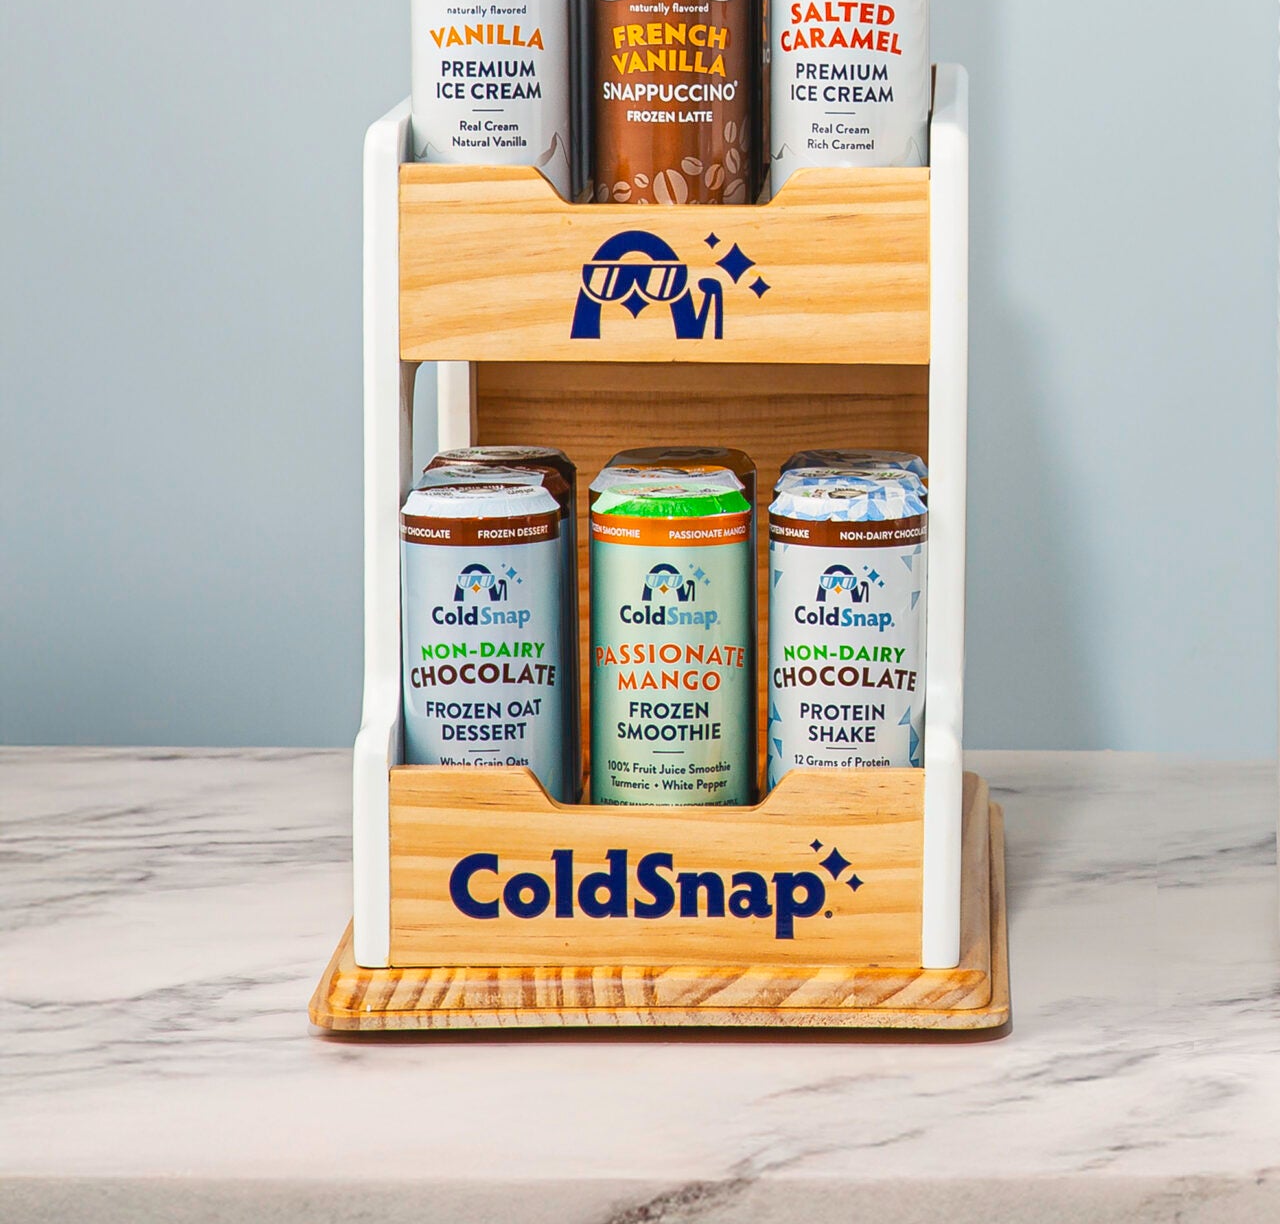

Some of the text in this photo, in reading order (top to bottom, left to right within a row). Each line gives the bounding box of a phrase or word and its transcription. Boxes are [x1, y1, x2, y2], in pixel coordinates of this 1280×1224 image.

[447, 5, 527, 18] naturally flavored
[629, 3, 709, 16] naturally flavored
[791, 1, 896, 26] SALTED
[429, 23, 545, 51] VANILLA
[612, 22, 728, 50] FRENCH
[780, 26, 903, 56] CARAMEL
[441, 60, 536, 78] PREMIUM
[611, 49, 727, 77] VANILLA
[796, 63, 889, 81] PREMIUM
[436, 81, 542, 100] ICE CREAM
[791, 84, 894, 103] ICE CREAM
[459, 120, 519, 131] Real Cream
[627, 110, 713, 123] FROZEN LATTE
[811, 122, 870, 135] Real Cream
[452, 136, 527, 147] Natural Vanilla
[807, 138, 875, 151] Rich Caramel
[407, 526, 451, 539] CHOCOLATE
[477, 525, 549, 539] FROZEN DESSERT
[602, 526, 640, 538] SMOOTHIE
[669, 525, 746, 539] PASSIONATE MANGO
[785, 528, 810, 539] SHAKE
[840, 531, 894, 541] NON-DAIRY
[431, 606, 531, 629] ColdSnap
[619, 605, 718, 630] ColdSnap
[794, 606, 893, 632] ColdSnap
[421, 642, 545, 661] NON-DAIRY
[596, 644, 745, 668] PASSIONATE
[784, 645, 906, 664] NON-DAIRY
[410, 663, 556, 688] CHOCOLATE
[617, 671, 721, 691] MANGO
[773, 666, 917, 692] CHOCOLATE
[426, 698, 542, 719] FROZEN OAT
[629, 701, 709, 719] FROZEN
[800, 702, 885, 721] PROTEIN
[442, 722, 527, 741] DESSERT
[617, 722, 721, 741] SMOOTHIE
[808, 725, 876, 742] SHAKE
[506, 756, 529, 766] Oats
[607, 760, 731, 775] 100% Fruit Juice Smoothie
[794, 754, 890, 767] 12 Grams of Protein
[610, 775, 728, 793] Turmeric White Pepper
[449, 849, 828, 939] ColdSnap
